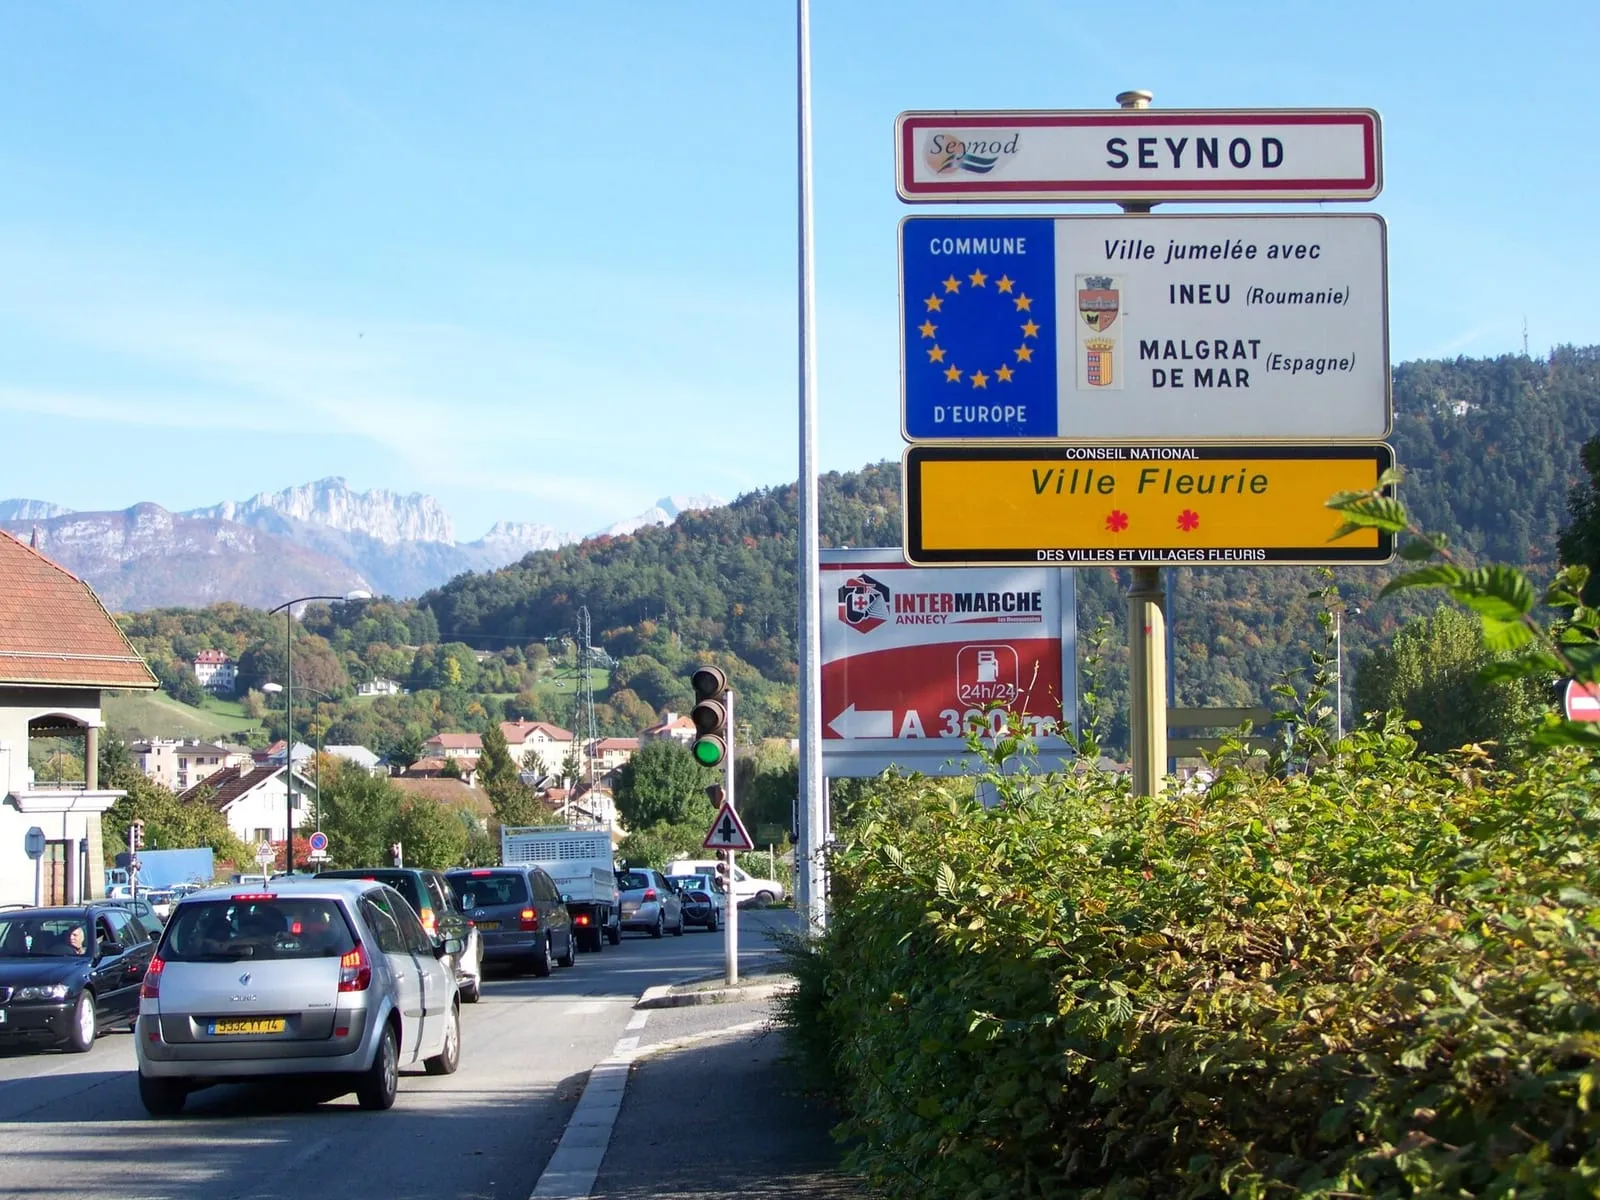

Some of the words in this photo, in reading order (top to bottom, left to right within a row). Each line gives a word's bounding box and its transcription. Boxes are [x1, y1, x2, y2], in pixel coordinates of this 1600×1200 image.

[930, 133, 1020, 160] Seynod
[1106, 137, 1284, 169] SEYNOD
[930, 238, 1026, 255] COMMUNE
[1104, 239, 1155, 260] Ville
[1164, 240, 1258, 264] jumelée
[1267, 245, 1321, 260] avec
[1169, 285, 1230, 304] INEU
[1246, 286, 1350, 306] (Roumanie)
[1139, 340, 1261, 360] MALGRAT
[1266, 352, 1356, 375] (Espagne)
[1152, 368, 1184, 388] DE
[1194, 368, 1250, 388] MAR
[934, 406, 1027, 423] D'EUROPE
[1066, 448, 1127, 460] CONSEIL
[1130, 448, 1200, 460] NATIONAL
[1032, 468, 1116, 495] Ville
[1137, 468, 1268, 495] Fleurie
[1036, 550, 1064, 561] DES
[1067, 550, 1115, 561] VILLES
[1118, 550, 1136, 561] ET
[1138, 549, 1207, 561] VILLAGES
[1208, 549, 1266, 561] FLEURIS
[894, 591, 1042, 613] INTERMARCHE
[895, 614, 948, 625] ANNECY
[961, 684, 1016, 699] 24h/24
[898, 709, 927, 738] A
[938, 708, 1009, 738] 300
